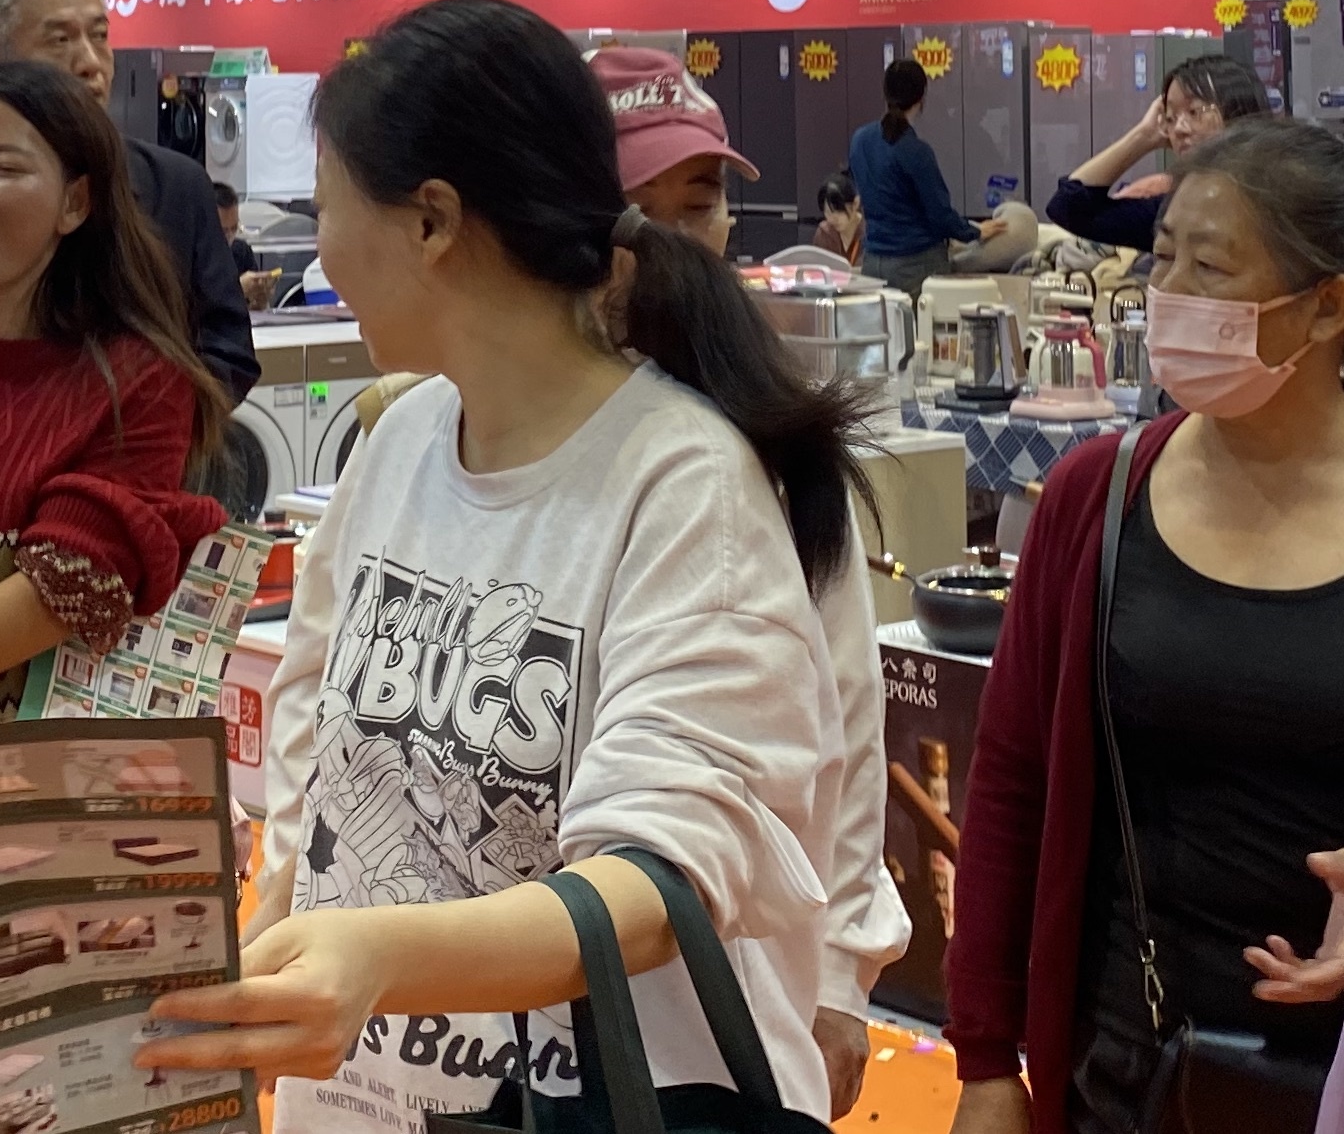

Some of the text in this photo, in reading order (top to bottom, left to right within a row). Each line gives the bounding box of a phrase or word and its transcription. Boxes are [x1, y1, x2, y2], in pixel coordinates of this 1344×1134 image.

[356, 637, 573, 774] BUGS
[439, 738, 474, 776] Bugs
[476, 754, 554, 805] Bunny
[315, 1087, 378, 1116] SOMETIMES
[342, 1068, 362, 1090] AND
[406, 1092, 450, 1114] LIVELY
[169, 1097, 241, 1132] 28800
